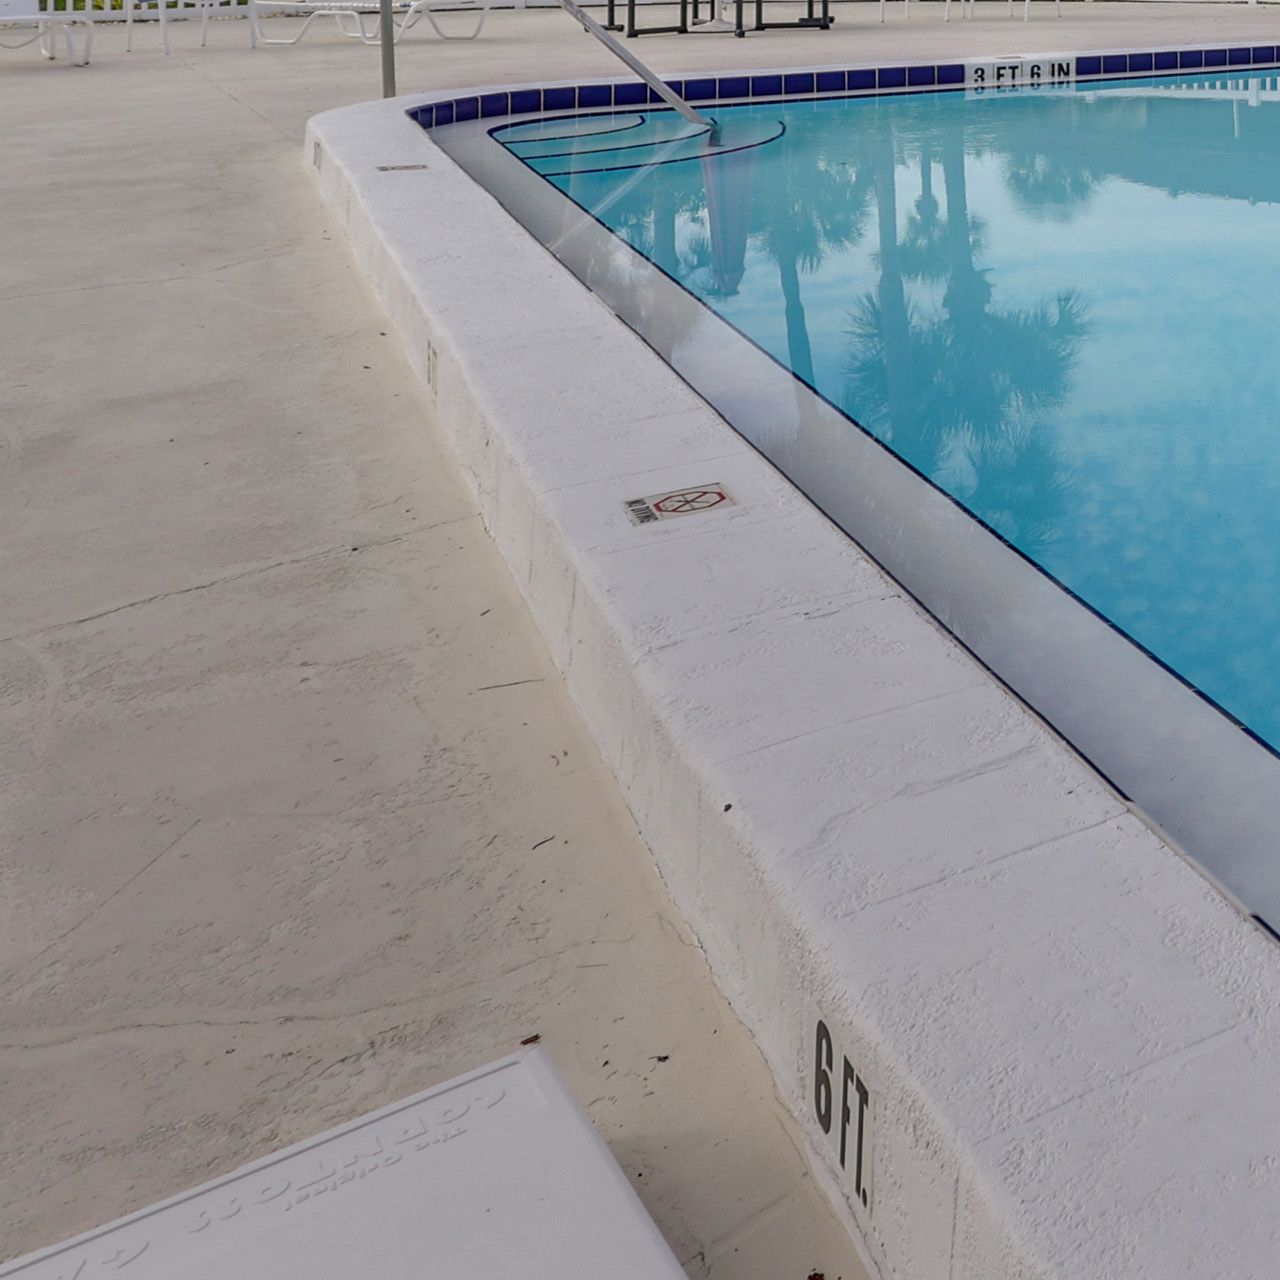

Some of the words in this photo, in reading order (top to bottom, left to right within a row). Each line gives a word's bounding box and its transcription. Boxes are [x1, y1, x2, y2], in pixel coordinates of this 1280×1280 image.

[973, 66, 986, 82] 3
[996, 64, 1020, 81] FT
[1050, 62, 1071, 77] IN
[814, 1019, 833, 1136] 6
[839, 1053, 870, 1209] FT.
